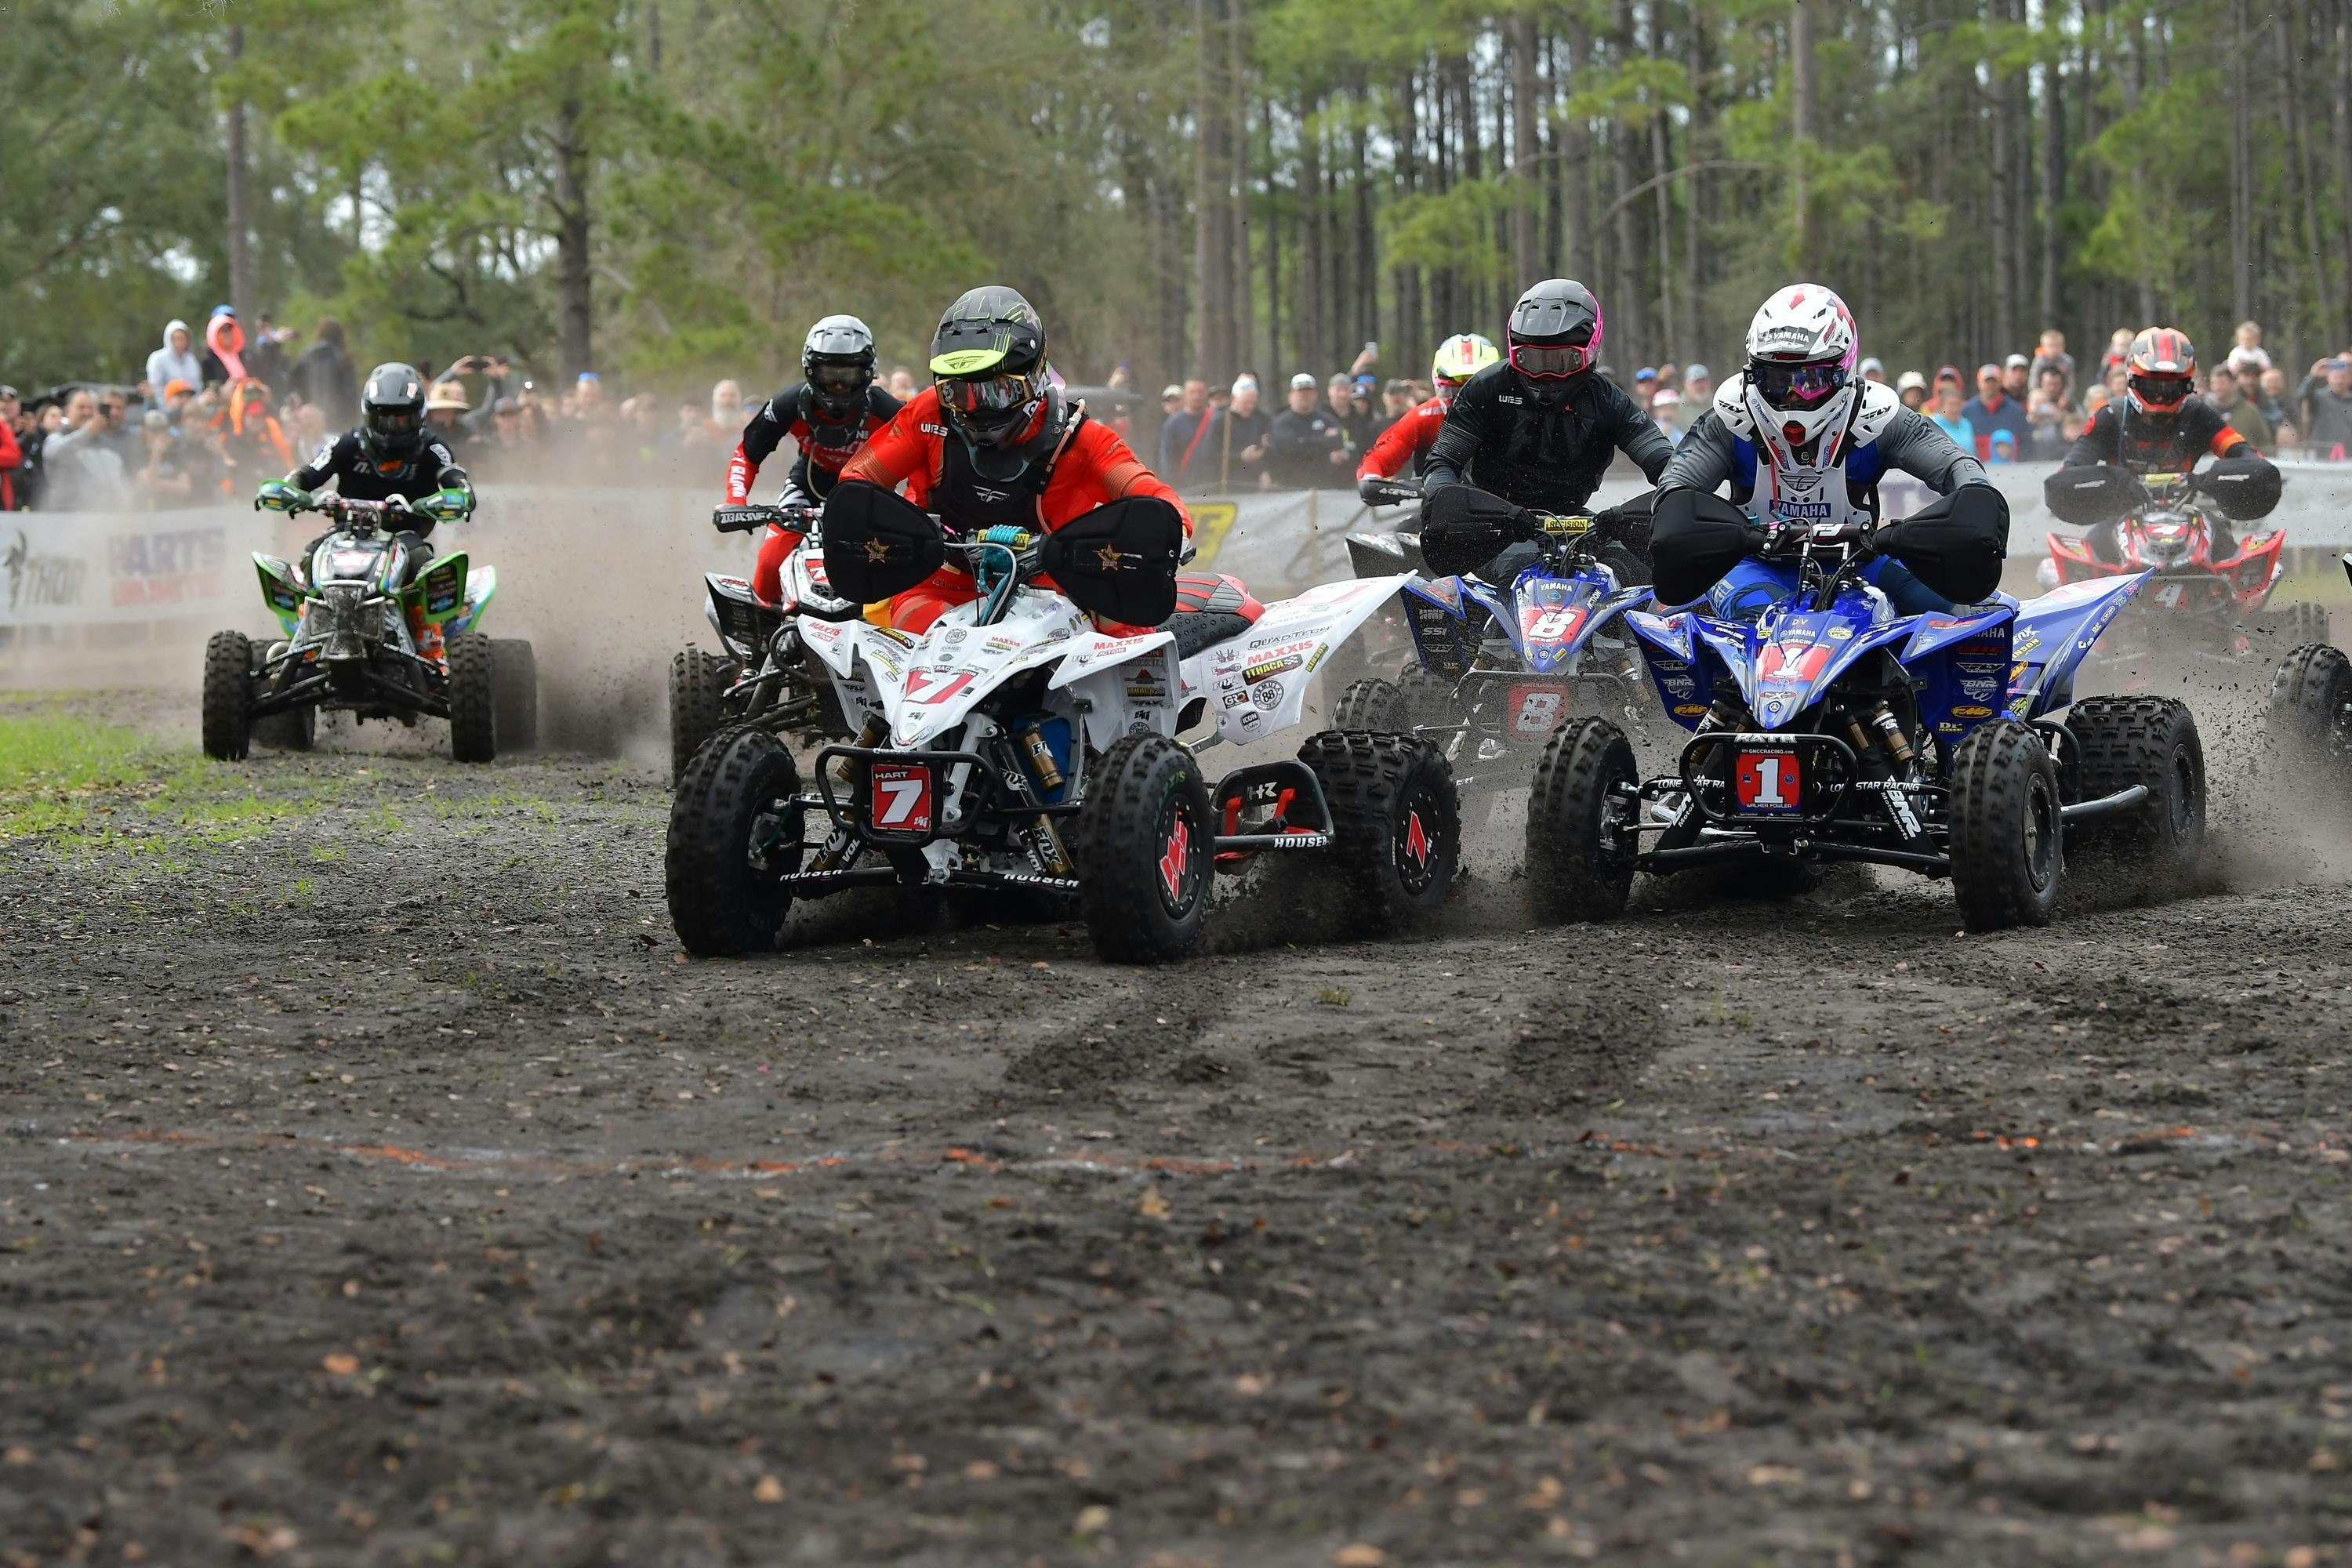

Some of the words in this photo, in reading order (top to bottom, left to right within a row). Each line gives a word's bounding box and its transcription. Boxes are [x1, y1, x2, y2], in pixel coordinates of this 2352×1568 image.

[1773, 331, 1809, 343] YAMAHA
[1719, 400, 1745, 413] FLY
[1754, 402, 1770, 424] YAMAHA
[1860, 405, 1892, 419] FLY
[1540, 583, 1573, 592] YAMAHA
[1587, 588, 1602, 610] ACTION
[1419, 608, 1445, 619] HMF
[808, 622, 842, 637] MAXXIS
[1422, 627, 1446, 636] SSI
[1528, 612, 1577, 638] 8
[1788, 629, 1816, 637] YAMAHA
[991, 637, 1020, 647] MAXXIS
[1093, 637, 1145, 650] MAXXIS
[1097, 648, 1127, 657] ACTION
[1247, 640, 1314, 666] MAXXIS
[1773, 647, 1803, 675] 1
[1245, 659, 1285, 679] ITHACA
[1261, 689, 1276, 702] 88
[1515, 693, 1561, 731] 8
[1242, 713, 1258, 725] ICON
[1733, 734, 1798, 743] RATH
[1657, 779, 1682, 789] LONE
[1754, 758, 1784, 804] 1
[1855, 782, 1880, 791] STAR
[1882, 782, 1921, 792] RACING
[880, 779, 923, 824] 7
[1880, 792, 1909, 841] Motorsports
[1886, 789, 1922, 838] BNR
[1273, 837, 1327, 848] HOUSER
[1031, 826, 1063, 873] FOX
